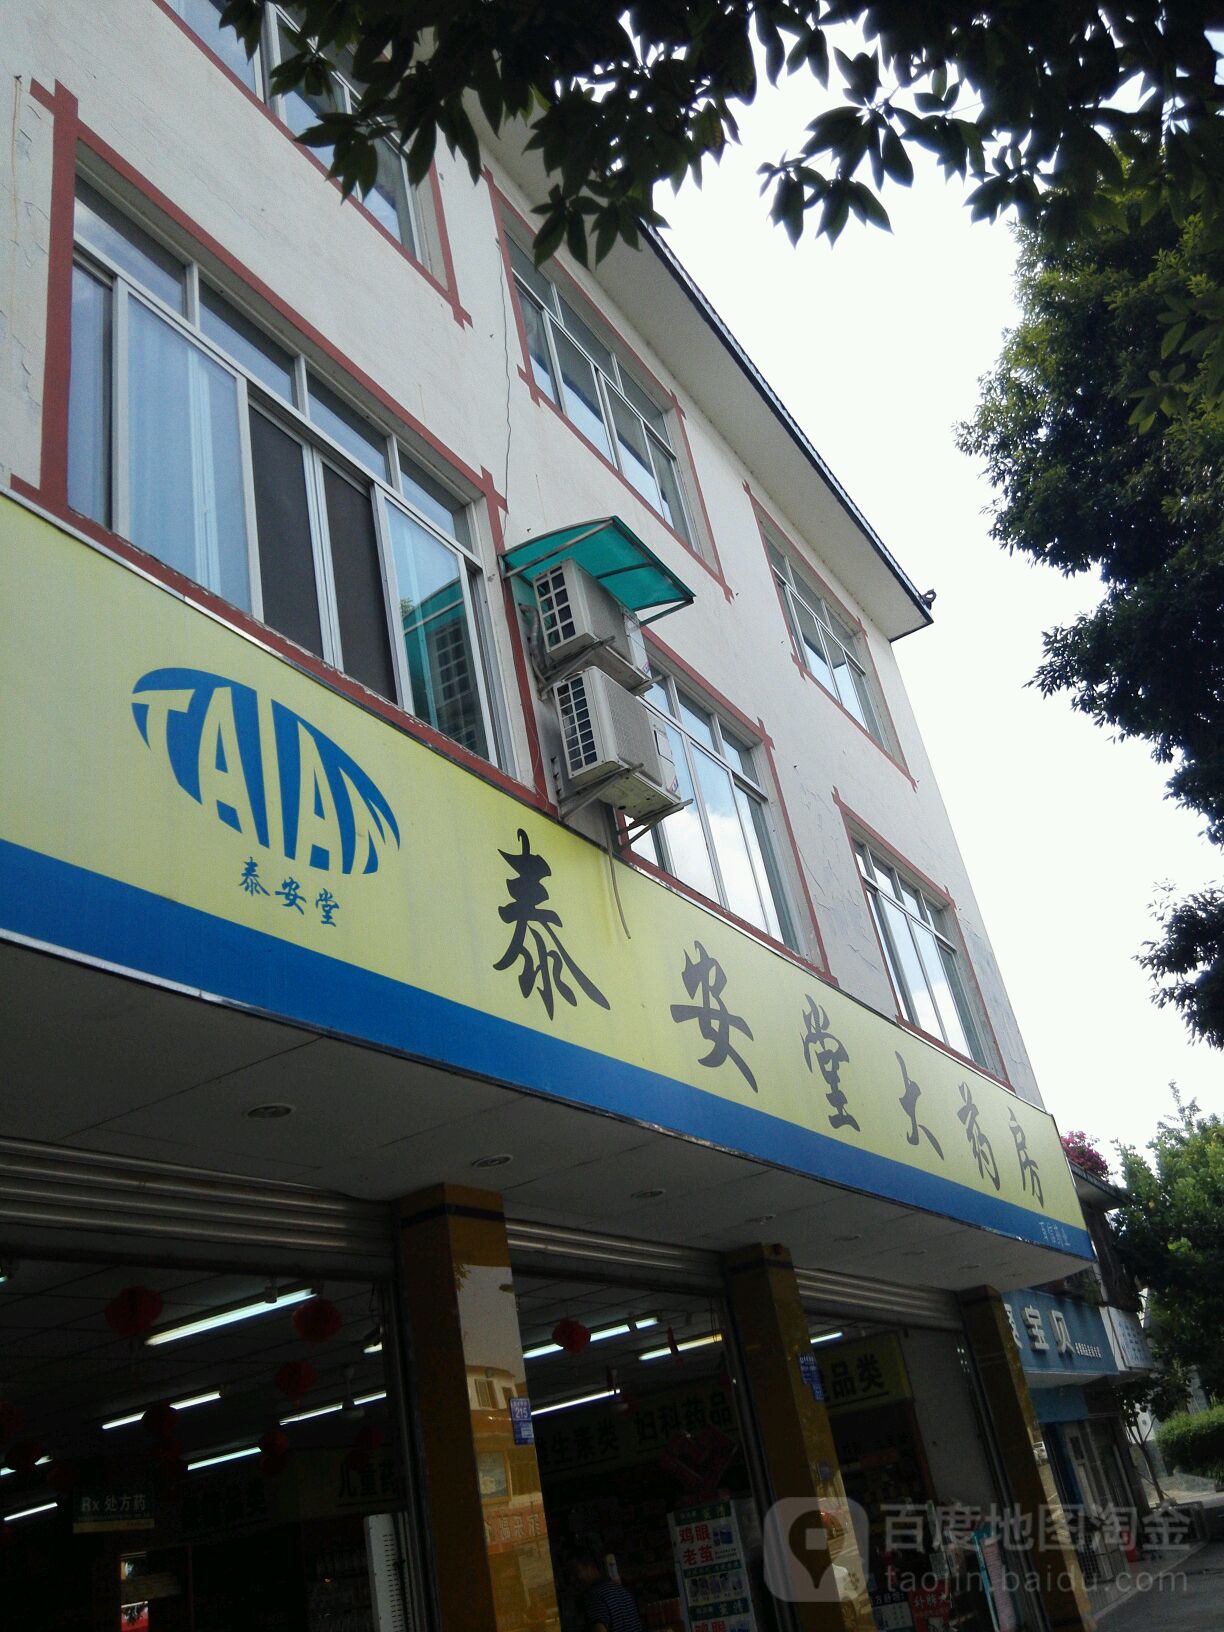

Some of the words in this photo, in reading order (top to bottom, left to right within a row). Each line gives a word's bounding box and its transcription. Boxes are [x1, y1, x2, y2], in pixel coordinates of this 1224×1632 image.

[238, 856, 340, 927] 泰安堂
[493, 828, 1045, 1208] 泰安堂大药房
[825, 1353, 885, 1400] 品类
[515, 1407, 528, 1419] 215
[82, 1498, 98, 1512] Rx
[104, 1494, 145, 1512] 处方药
[679, 1523, 711, 1544] 鸡眼
[682, 1544, 715, 1566] 老茧
